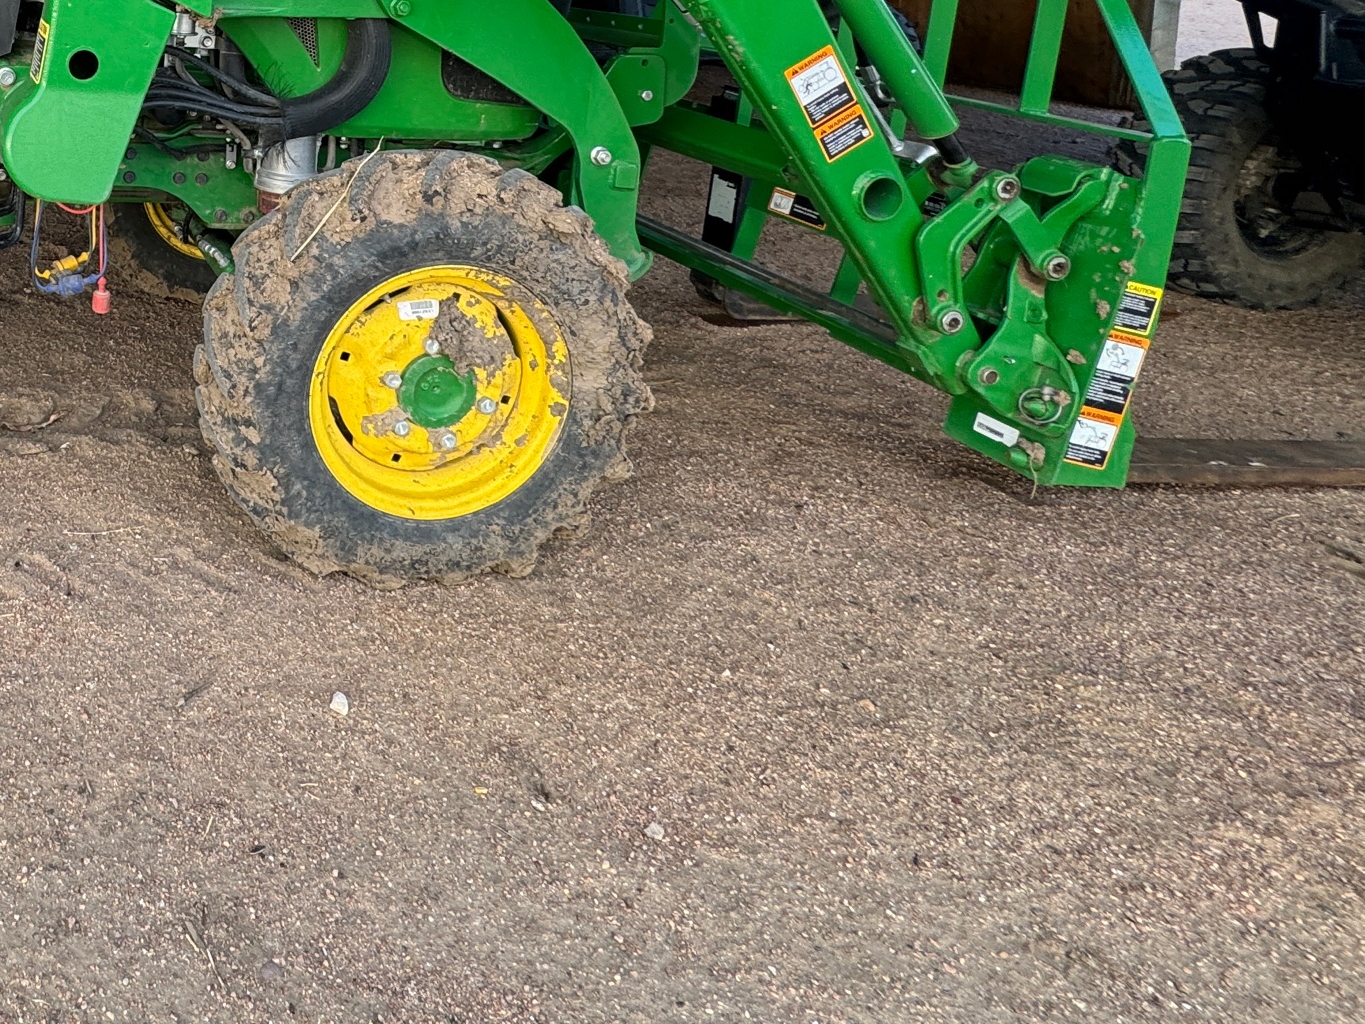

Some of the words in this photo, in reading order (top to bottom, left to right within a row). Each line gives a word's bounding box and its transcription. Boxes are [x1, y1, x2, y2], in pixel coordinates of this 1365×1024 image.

[797, 51, 828, 71] WARNING
[827, 109, 857, 130] WARNING
[1128, 284, 1157, 296] CAUTION
